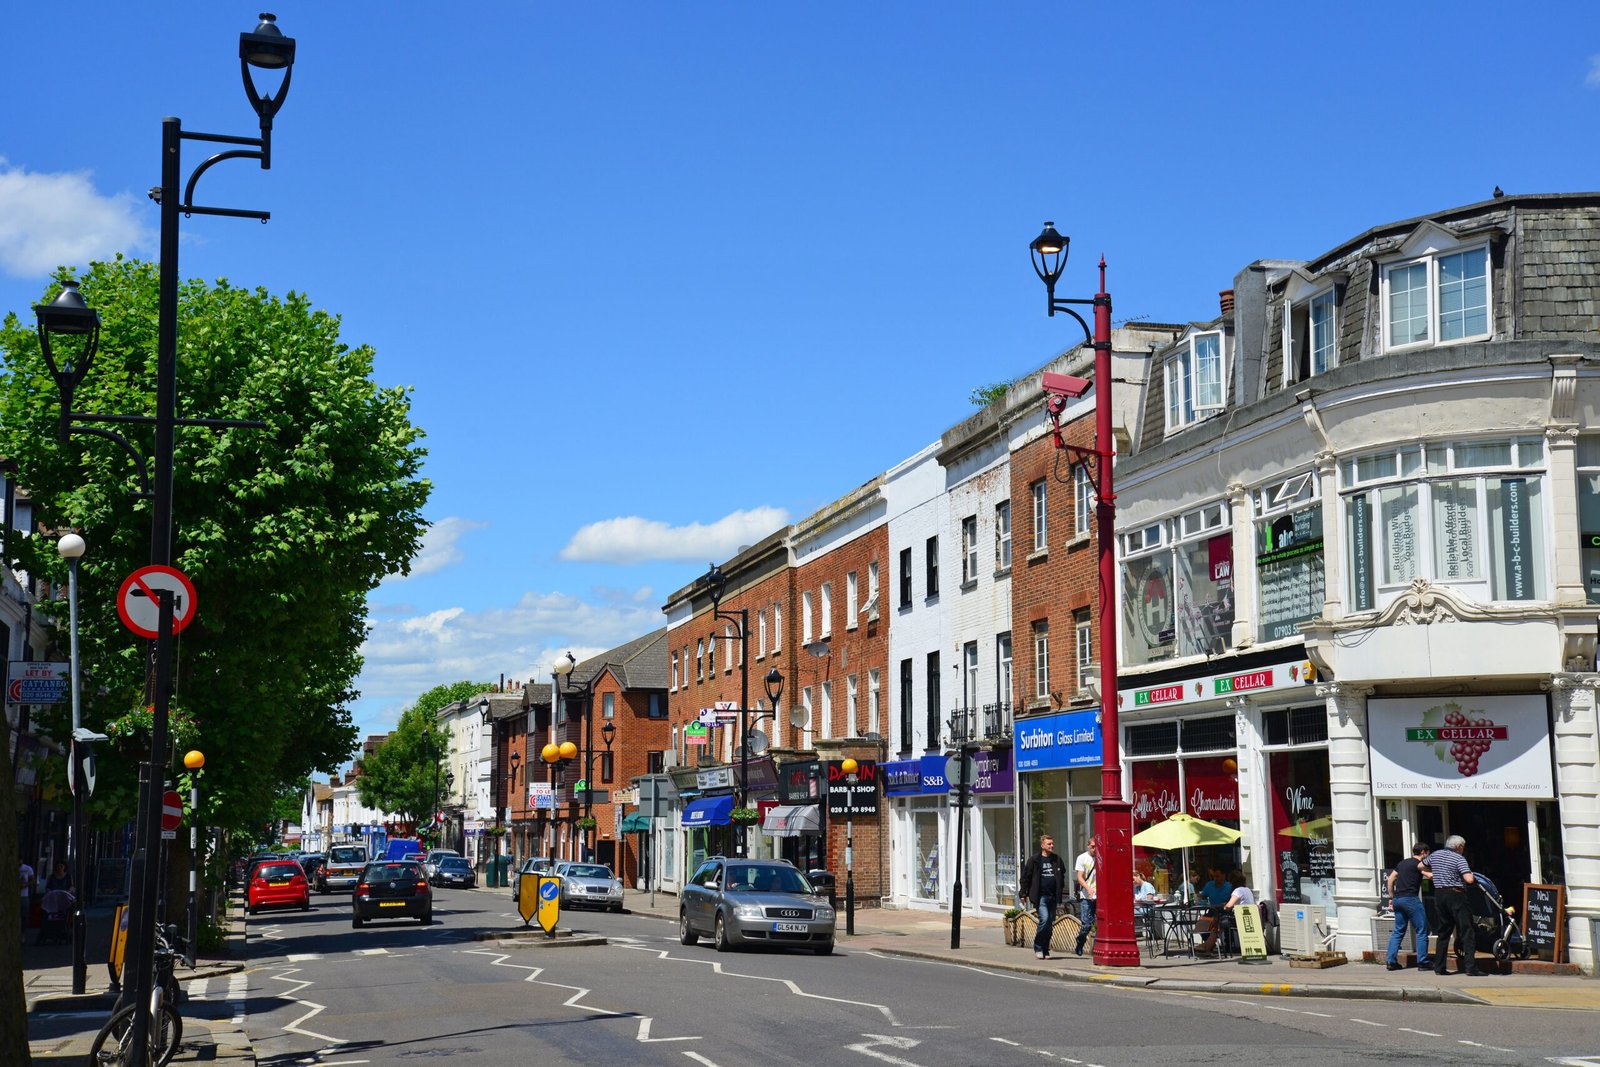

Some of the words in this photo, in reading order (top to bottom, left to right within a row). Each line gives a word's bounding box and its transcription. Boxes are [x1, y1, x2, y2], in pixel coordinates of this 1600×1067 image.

[1392, 531, 1401, 571] Building
[1458, 537, 1468, 562] Local
[1510, 482, 1522, 598] www.a-b-c-builders.com
[1215, 565, 1230, 580] LAW
[1220, 679, 1230, 692] EX
[1234, 674, 1266, 689] CELLAR
[1139, 692, 1148, 704] EX
[1151, 688, 1178, 702] CELLAR
[1021, 728, 1053, 750] Surbiton
[1057, 731, 1072, 744] Glass
[1074, 727, 1094, 743] Limited
[1417, 730, 1434, 740] EX
[1442, 729, 1496, 740] CELLAR
[924, 776, 944, 786] S&B
[1436, 782, 1461, 790] Winery
[1131, 791, 1153, 819] Coffee
[1158, 790, 1180, 819] Cake
[1191, 788, 1236, 818] Charcuterie
[1286, 785, 1314, 814] Wine
